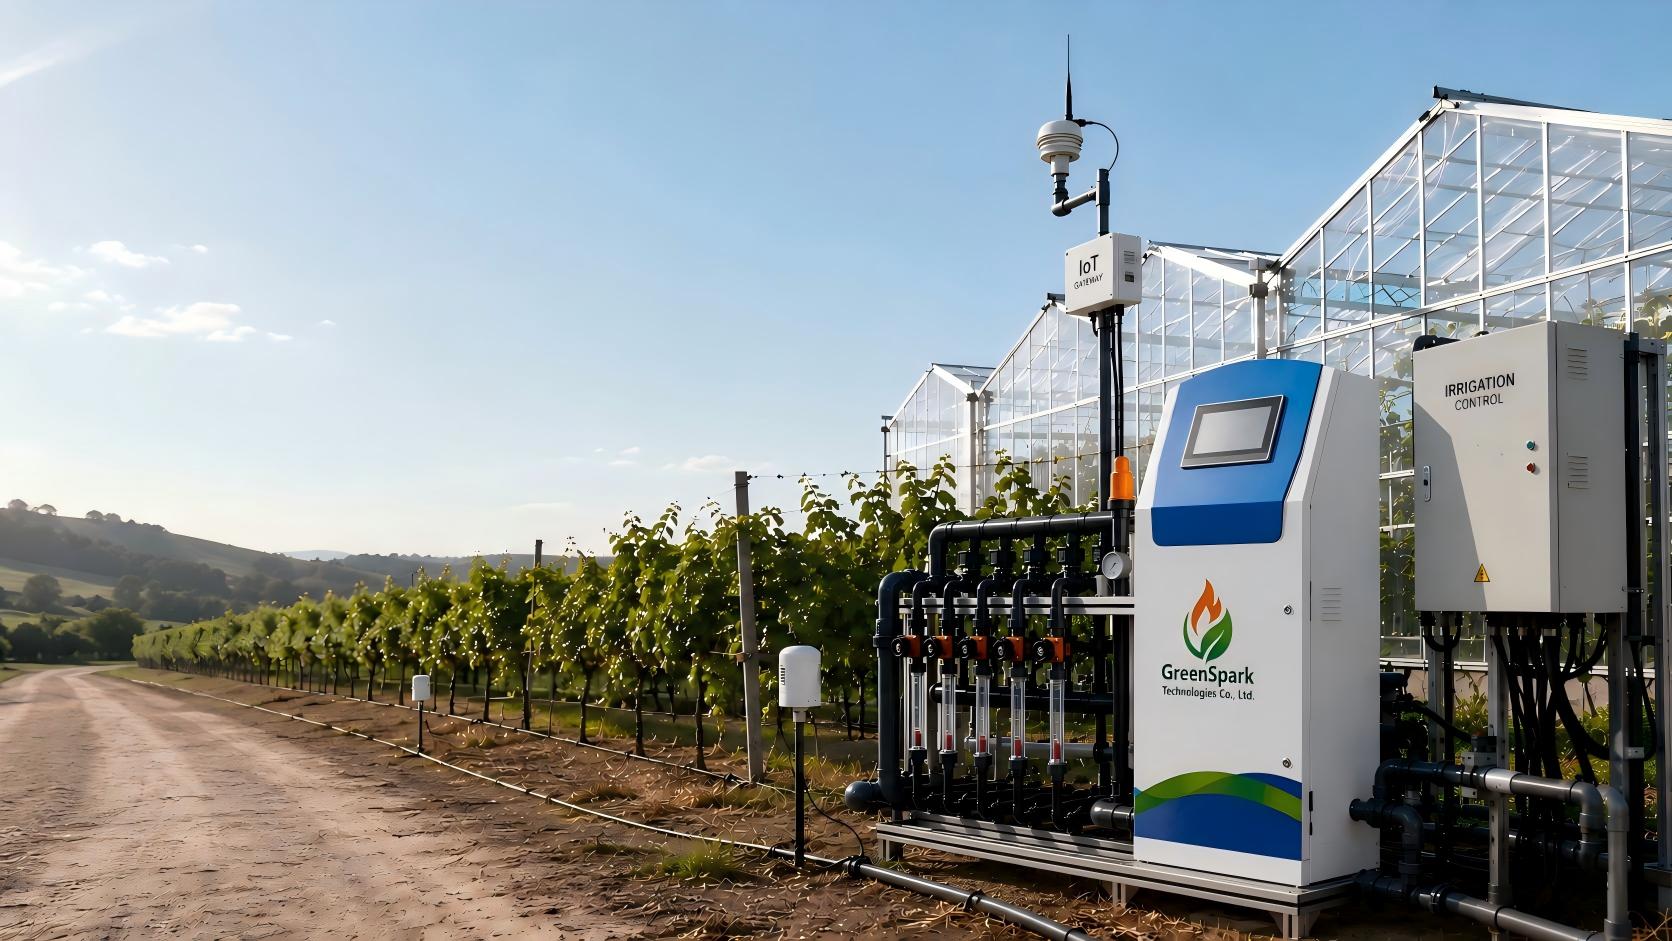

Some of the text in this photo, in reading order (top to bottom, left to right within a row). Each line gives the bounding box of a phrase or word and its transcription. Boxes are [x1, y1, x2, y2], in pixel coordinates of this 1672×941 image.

[1079, 254, 1099, 277] IoT
[1445, 372, 1515, 398] IRRIGATION
[1455, 393, 1504, 411] CONTROL
[1161, 663, 1255, 688] GreenSpark
[1161, 685, 1255, 701] Technologies Co., Ltd.
